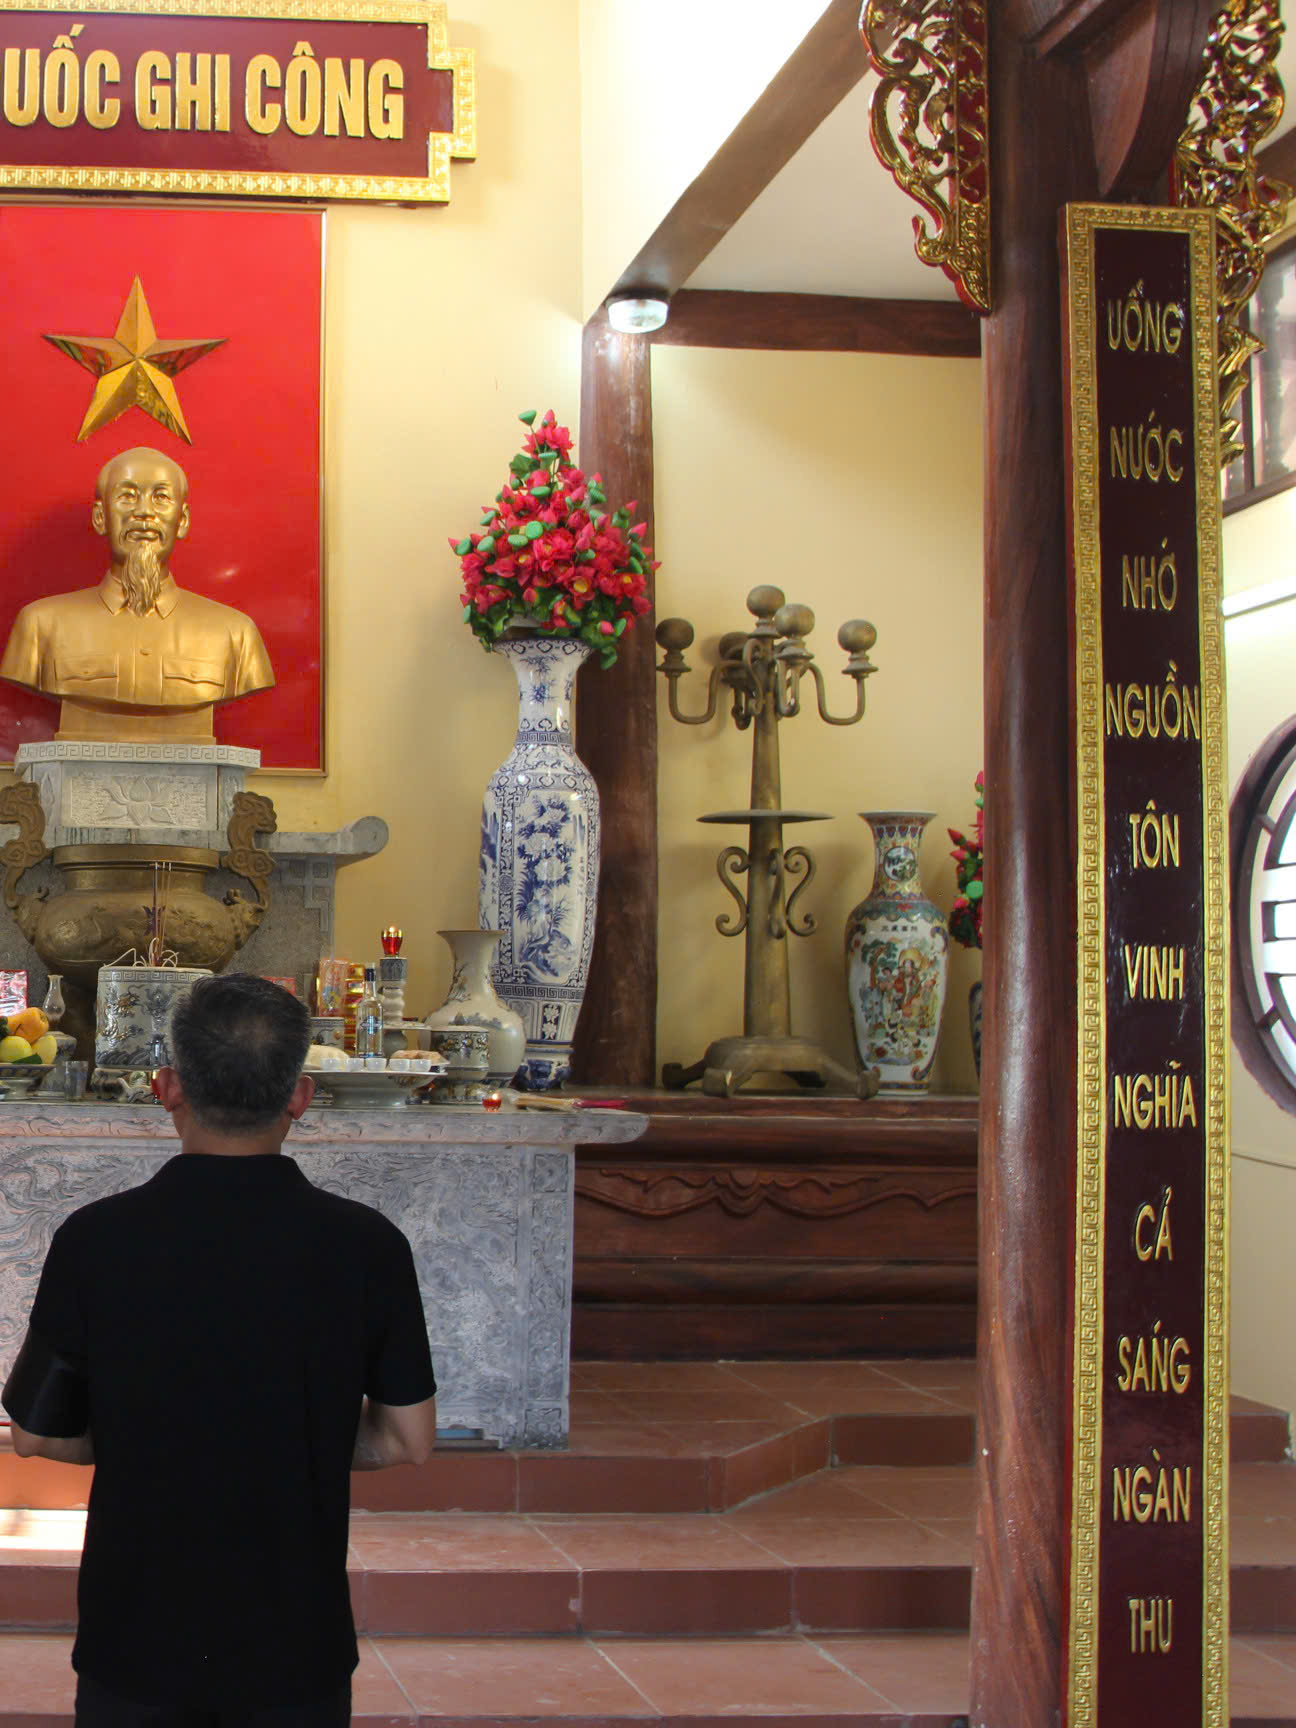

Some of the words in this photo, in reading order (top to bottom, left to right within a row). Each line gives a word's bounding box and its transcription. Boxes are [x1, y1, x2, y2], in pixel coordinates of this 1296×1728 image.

[135, 50, 232, 132] GHI
[245, 41, 405, 140] CÔNG
[1107, 280, 1183, 354] UỐNG
[1109, 410, 1184, 483] NƯỚC
[1121, 536, 1178, 612] NHỚ
[1105, 659, 1201, 740] NGUỒN
[1128, 799, 1180, 869] TÔN
[1124, 944, 1185, 1001] VINH
[1114, 1060, 1198, 1129] NGHĨA
[1135, 1187, 1174, 1261] CẢ
[1117, 1320, 1192, 1394] SÁNG
[1113, 1448, 1192, 1523] NGÀN
[1128, 1598, 1174, 1655] THU
